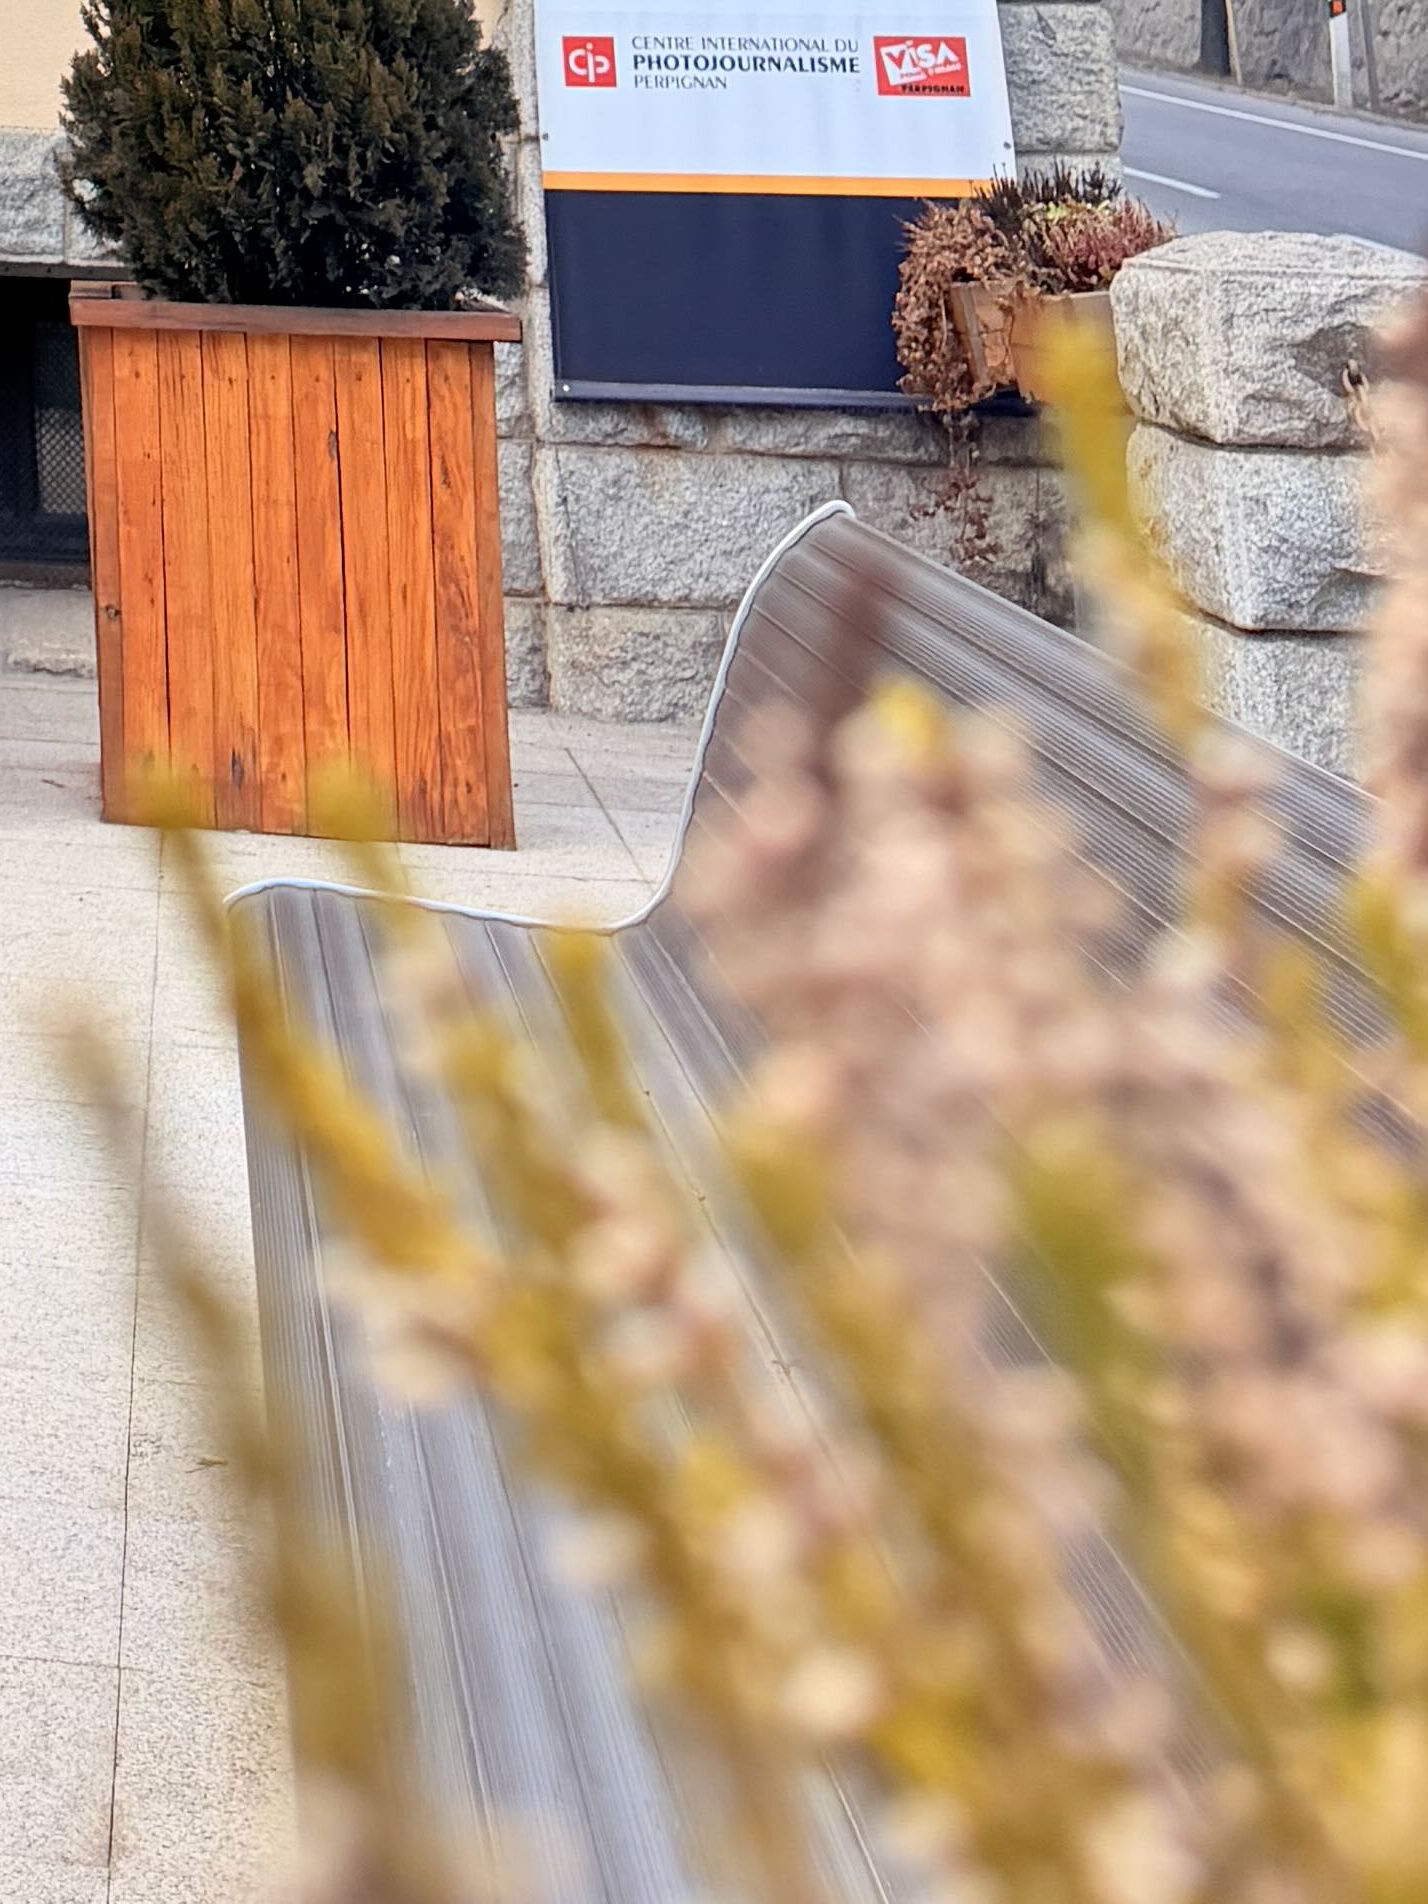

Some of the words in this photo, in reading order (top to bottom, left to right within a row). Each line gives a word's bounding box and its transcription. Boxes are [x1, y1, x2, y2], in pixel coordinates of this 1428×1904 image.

[632, 36, 694, 50] CENTRE
[702, 36, 830, 52] INTERNATIONAL
[835, 38, 859, 52] DU
[633, 54, 861, 73] PHOTOJOURNALISME
[634, 74, 727, 89] PERPIGNAN
